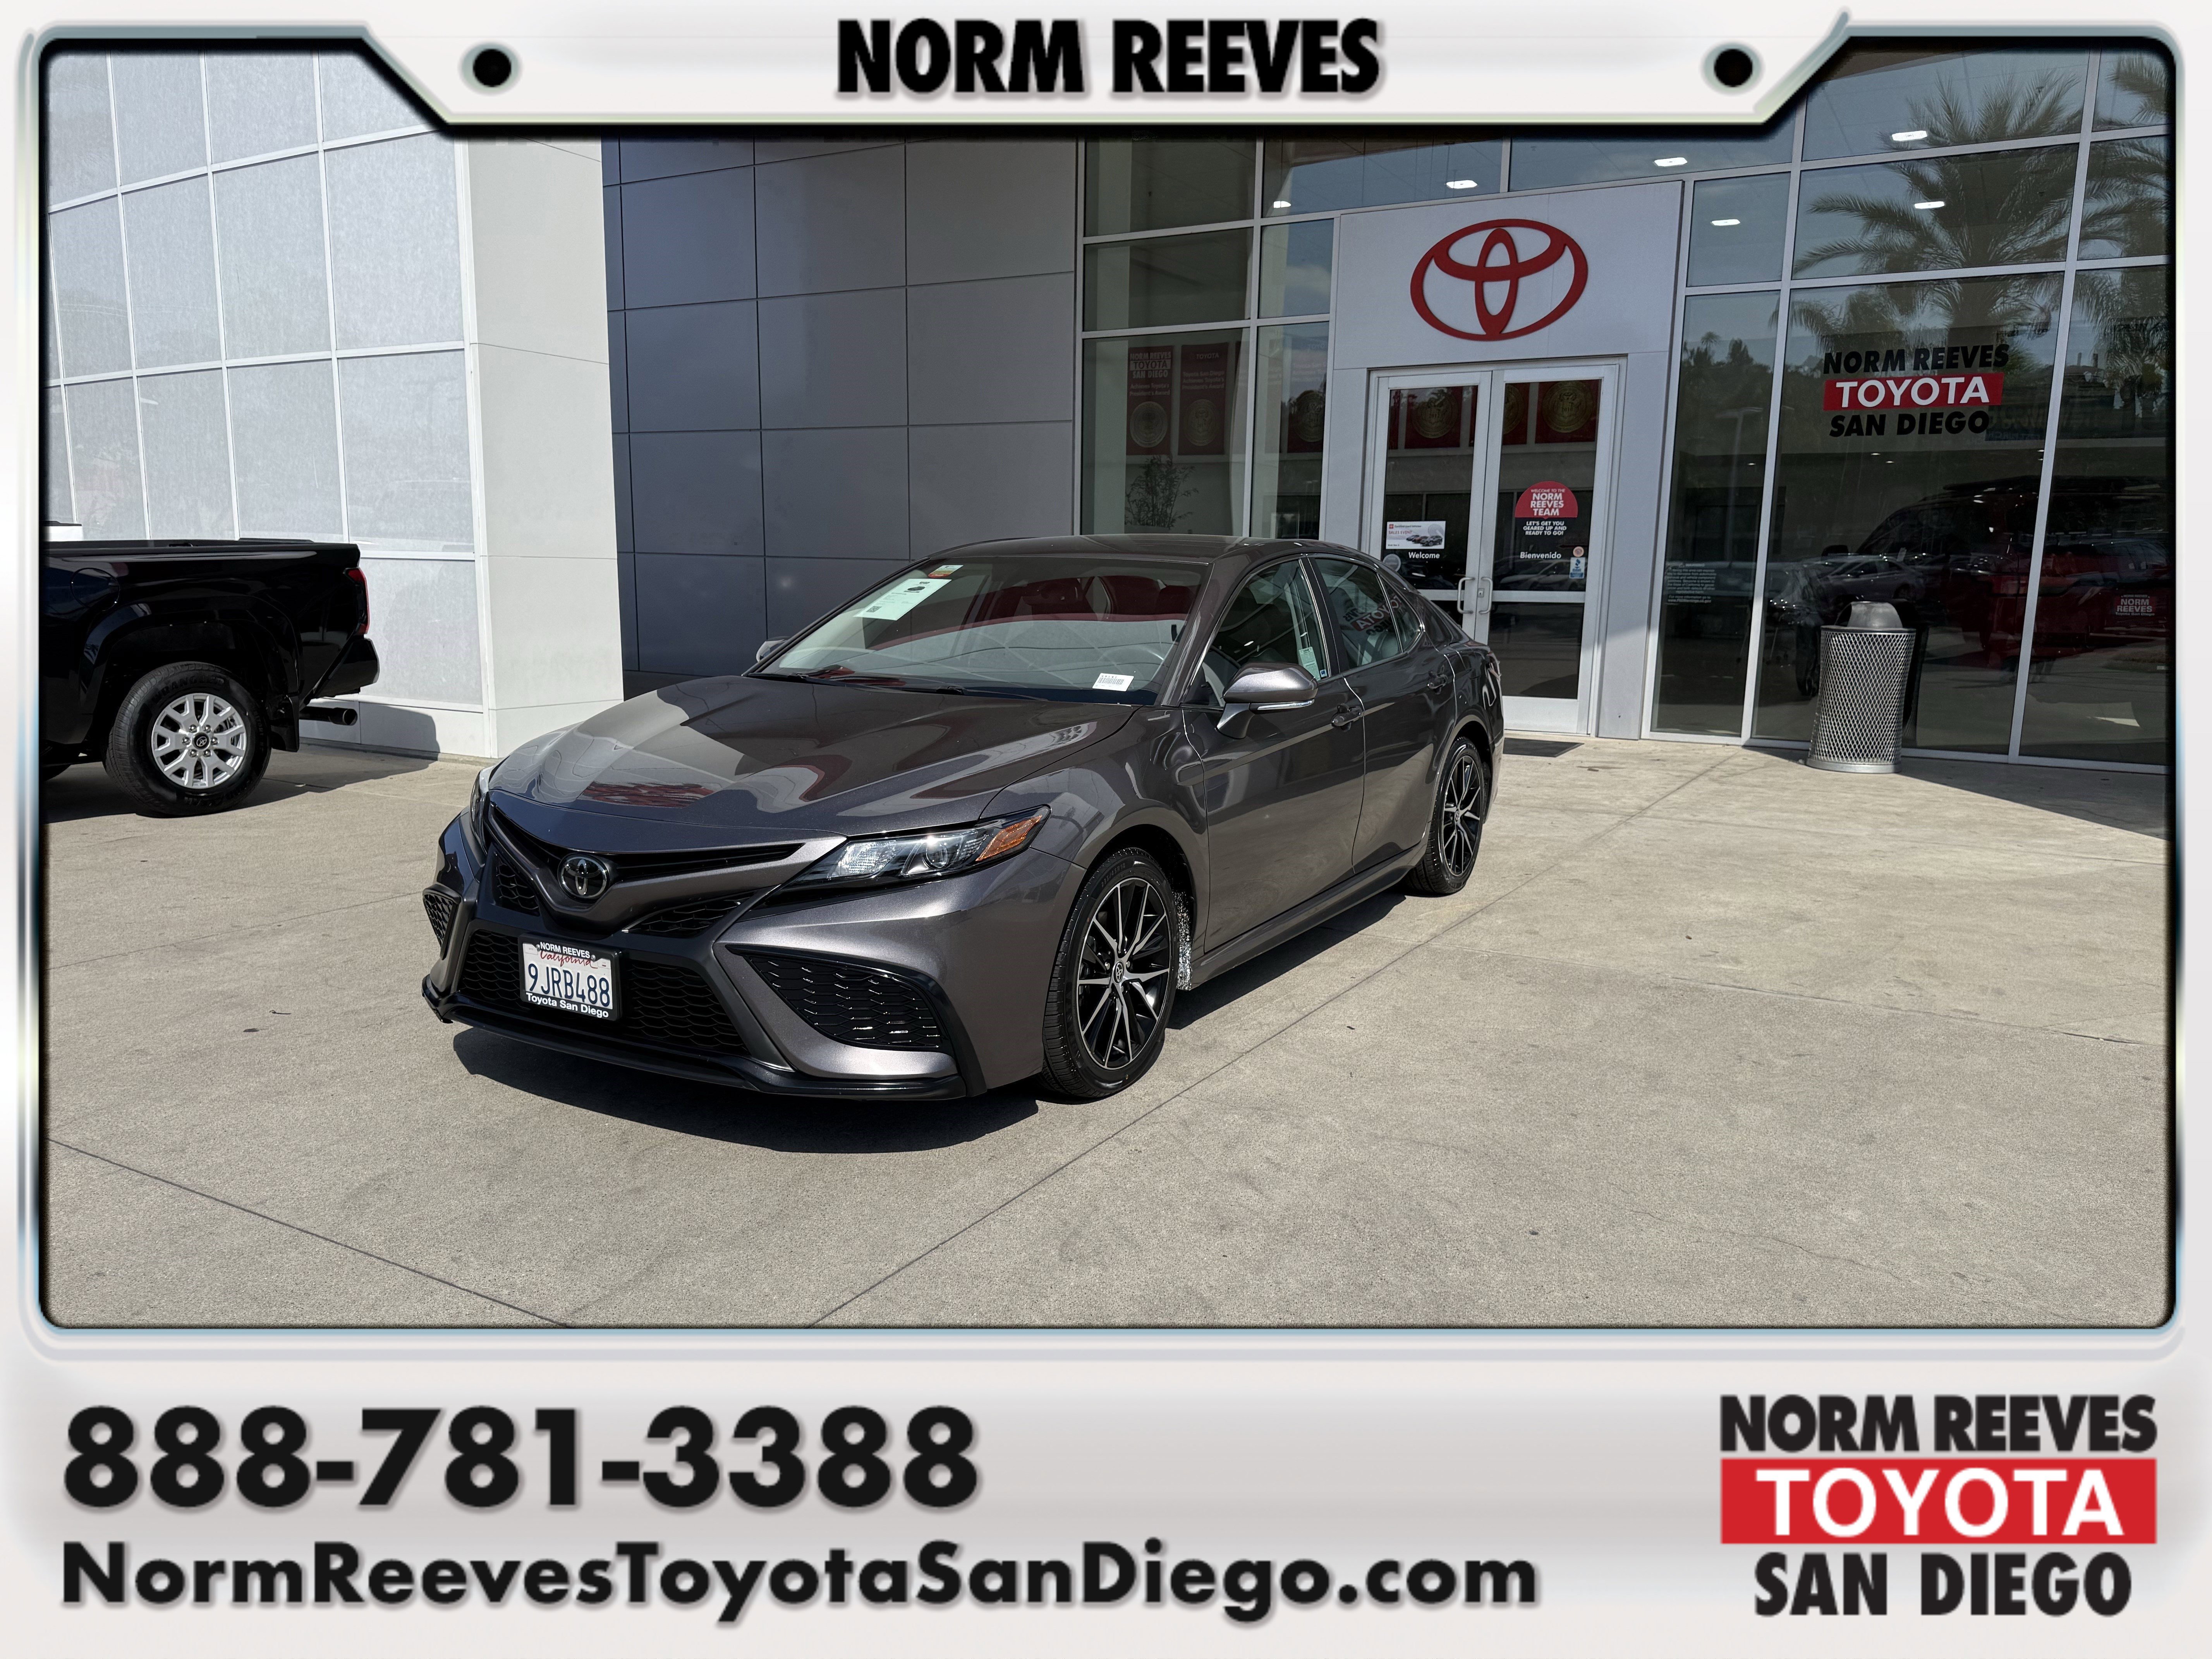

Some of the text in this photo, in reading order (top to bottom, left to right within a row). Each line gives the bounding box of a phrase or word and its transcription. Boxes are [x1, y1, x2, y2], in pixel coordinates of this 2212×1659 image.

[1133, 361, 1167, 369] TOYOTA
[1823, 344, 2010, 374] NORM REEVES
[1132, 370, 1168, 379] SAN DIEGO
[1836, 376, 1990, 408] TOYOTA
[1829, 414, 1886, 438] SAN
[1897, 410, 1990, 436] DIEGO
[1530, 500, 1564, 508] REEVES
[540, 942, 591, 958] NORM REEVES
[540, 950, 598, 969] California
[528, 963, 610, 1007] 9JRB488
[526, 992, 609, 1018] Toyota San Diego
